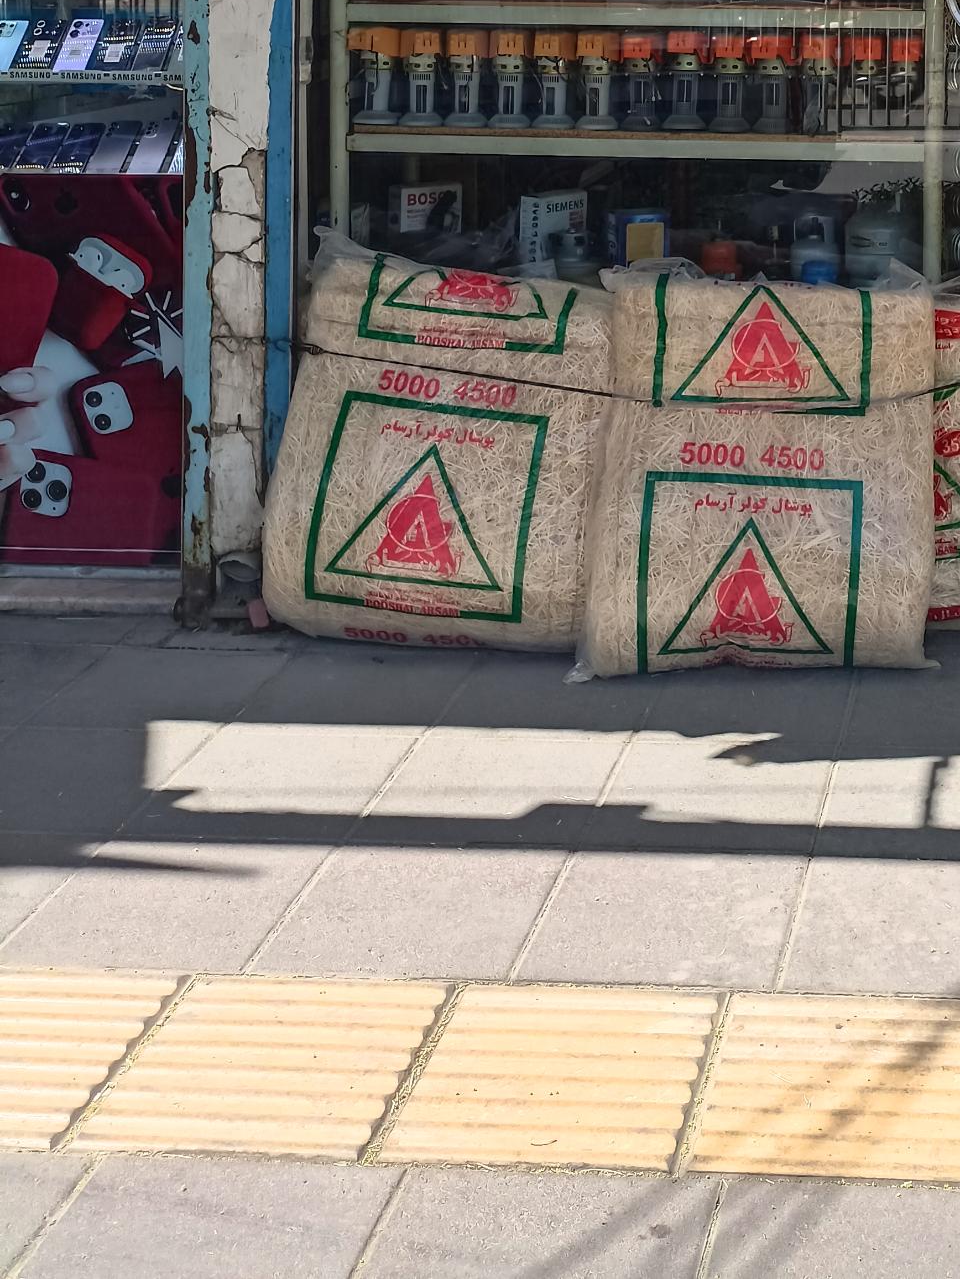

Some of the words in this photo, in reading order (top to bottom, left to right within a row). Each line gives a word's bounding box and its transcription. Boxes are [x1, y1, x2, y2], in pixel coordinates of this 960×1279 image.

[9, 71, 51, 79] SAMSUNG
[60, 72, 102, 80] SAMSUNG
[112, 73, 153, 81] SAMSUNG
[546, 199, 585, 214] SIEMENS
[378, 369, 441, 400] 5000
[453, 377, 518, 409] 4500
[679, 441, 746, 468] 5000
[759, 444, 825, 472] 4500
[694, 491, 737, 513] آرسام
[737, 496, 768, 513] کولر
[771, 497, 814, 519] پوشال
[343, 626, 409, 644] 5000
